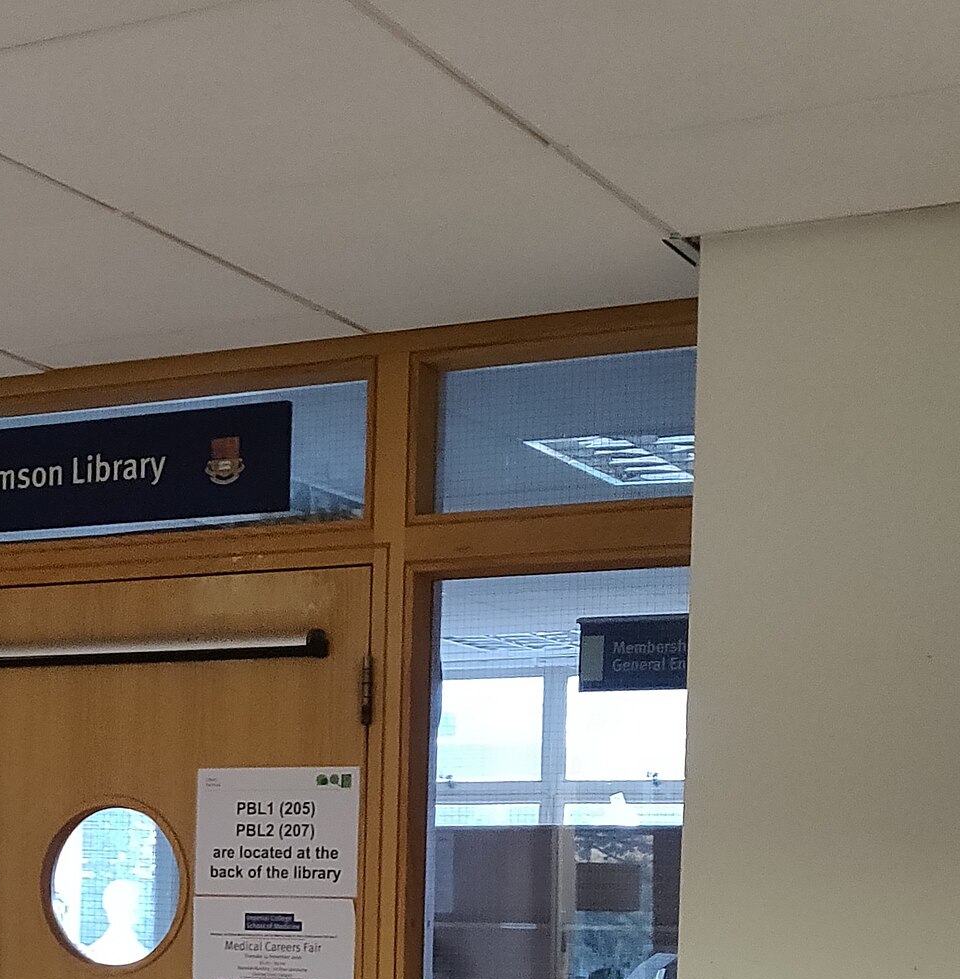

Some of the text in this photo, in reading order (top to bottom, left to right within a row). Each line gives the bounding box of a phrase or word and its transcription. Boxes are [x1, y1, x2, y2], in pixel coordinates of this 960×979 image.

[72, 453, 167, 486] Library
[612, 657, 665, 671] General
[236, 801, 315, 818] PBL1 (205)
[236, 824, 315, 840] PBL2 (207)
[213, 846, 339, 859] are located at the
[210, 865, 341, 883] back of the library
[224, 940, 322, 953] Medical Careers Fair
